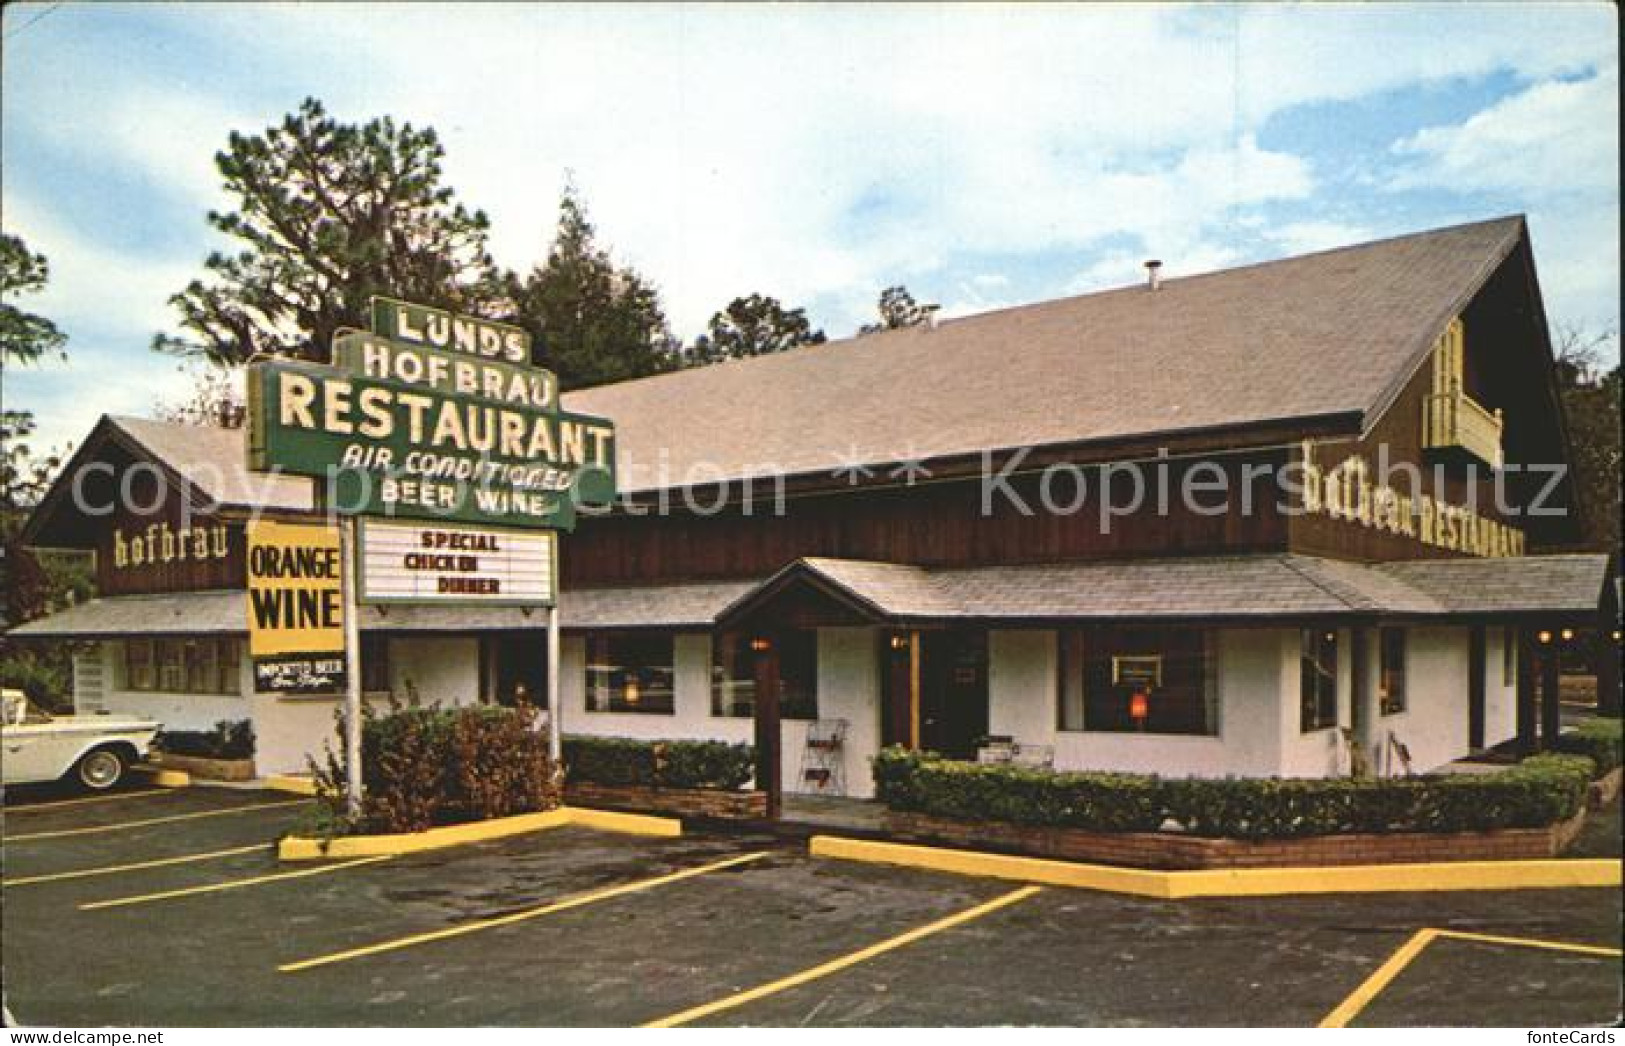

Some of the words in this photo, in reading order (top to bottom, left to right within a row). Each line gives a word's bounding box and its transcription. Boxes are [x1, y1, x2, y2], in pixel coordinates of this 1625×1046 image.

[363, 342, 553, 406] HOFBRAU
[279, 371, 615, 468] RESTAURANT
[342, 444, 394, 469] AIR
[380, 477, 454, 507] BEER
[475, 489, 546, 516] WINE
[113, 522, 229, 568] hofbrau
[421, 530, 500, 551] SPECIAL
[251, 546, 339, 579] ORANGE
[251, 588, 342, 630] WINE
